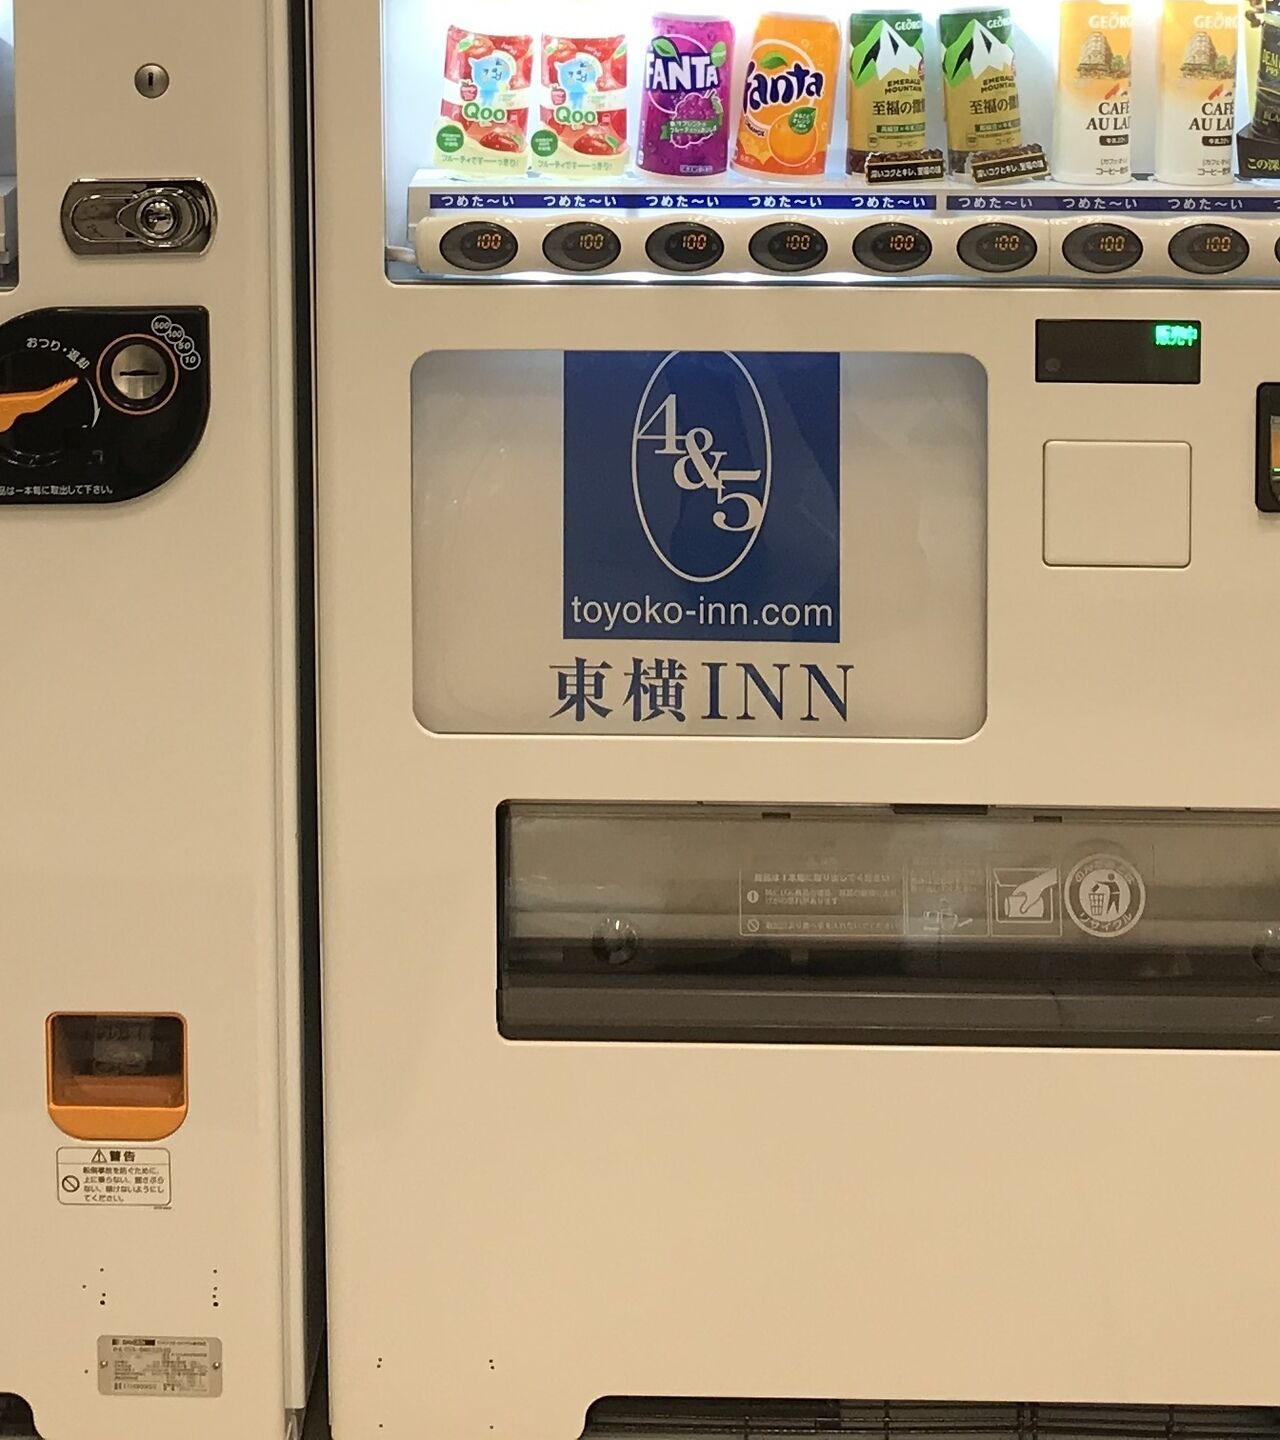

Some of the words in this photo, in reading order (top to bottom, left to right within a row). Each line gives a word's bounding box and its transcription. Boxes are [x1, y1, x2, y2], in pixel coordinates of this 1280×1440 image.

[645, 52, 719, 90] FANTA
[744, 61, 825, 114] Fanta
[462, 102, 506, 122] Qoo
[555, 106, 597, 125] Qoo
[476, 233, 502, 250] 100
[888, 234, 915, 251] 100
[1098, 234, 1126, 251] 100
[26, 336, 90, 370] おつり・返却
[636, 393, 765, 532] 4&5
[570, 594, 834, 632] toyoko-inn.com
[548, 656, 856, 724] 東横INN
[109, 1150, 136, 1162] 警告
